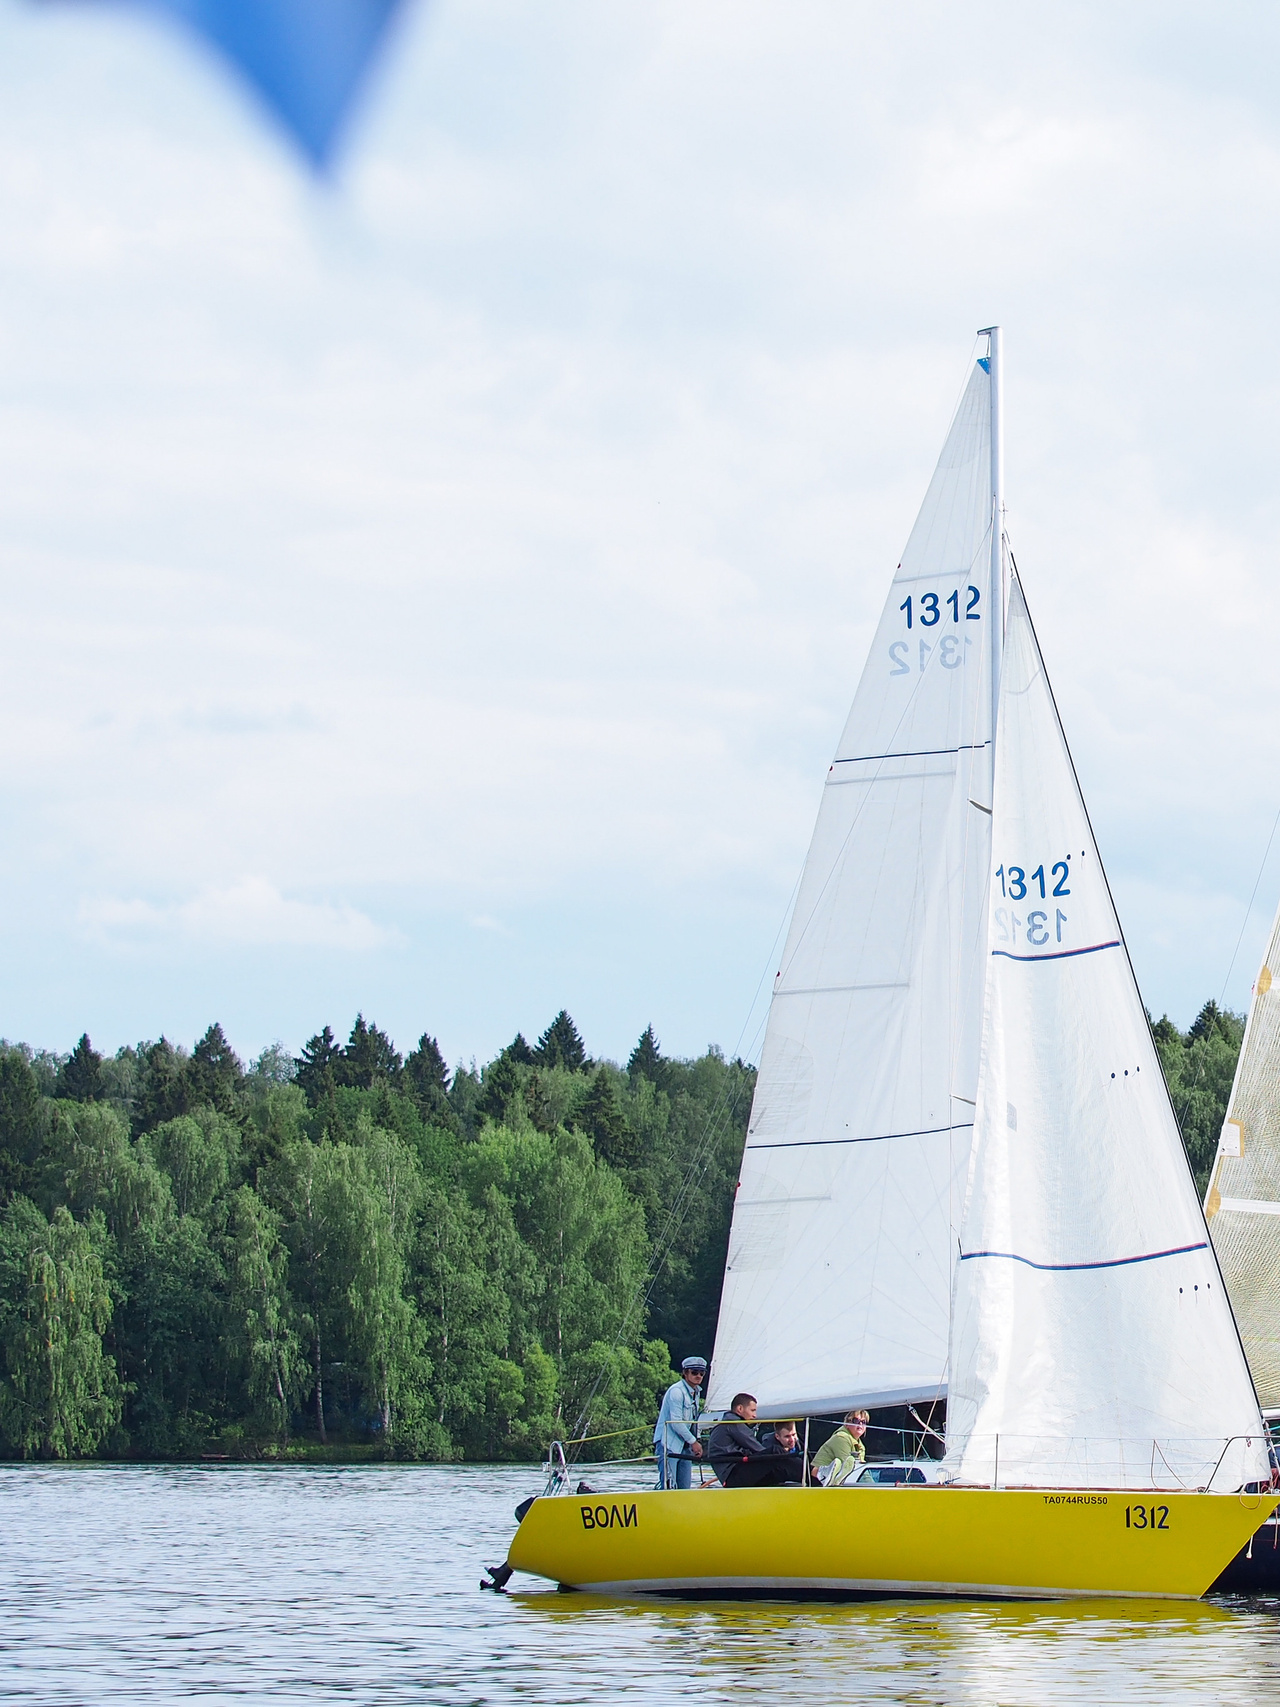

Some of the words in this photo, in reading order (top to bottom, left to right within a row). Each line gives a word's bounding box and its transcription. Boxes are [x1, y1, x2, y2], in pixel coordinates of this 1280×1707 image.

[899, 585, 981, 629] 1312
[995, 861, 1071, 900] 1312
[1043, 1496, 1108, 1505] TA0744RUS50
[1125, 1505, 1170, 1529] 1312
